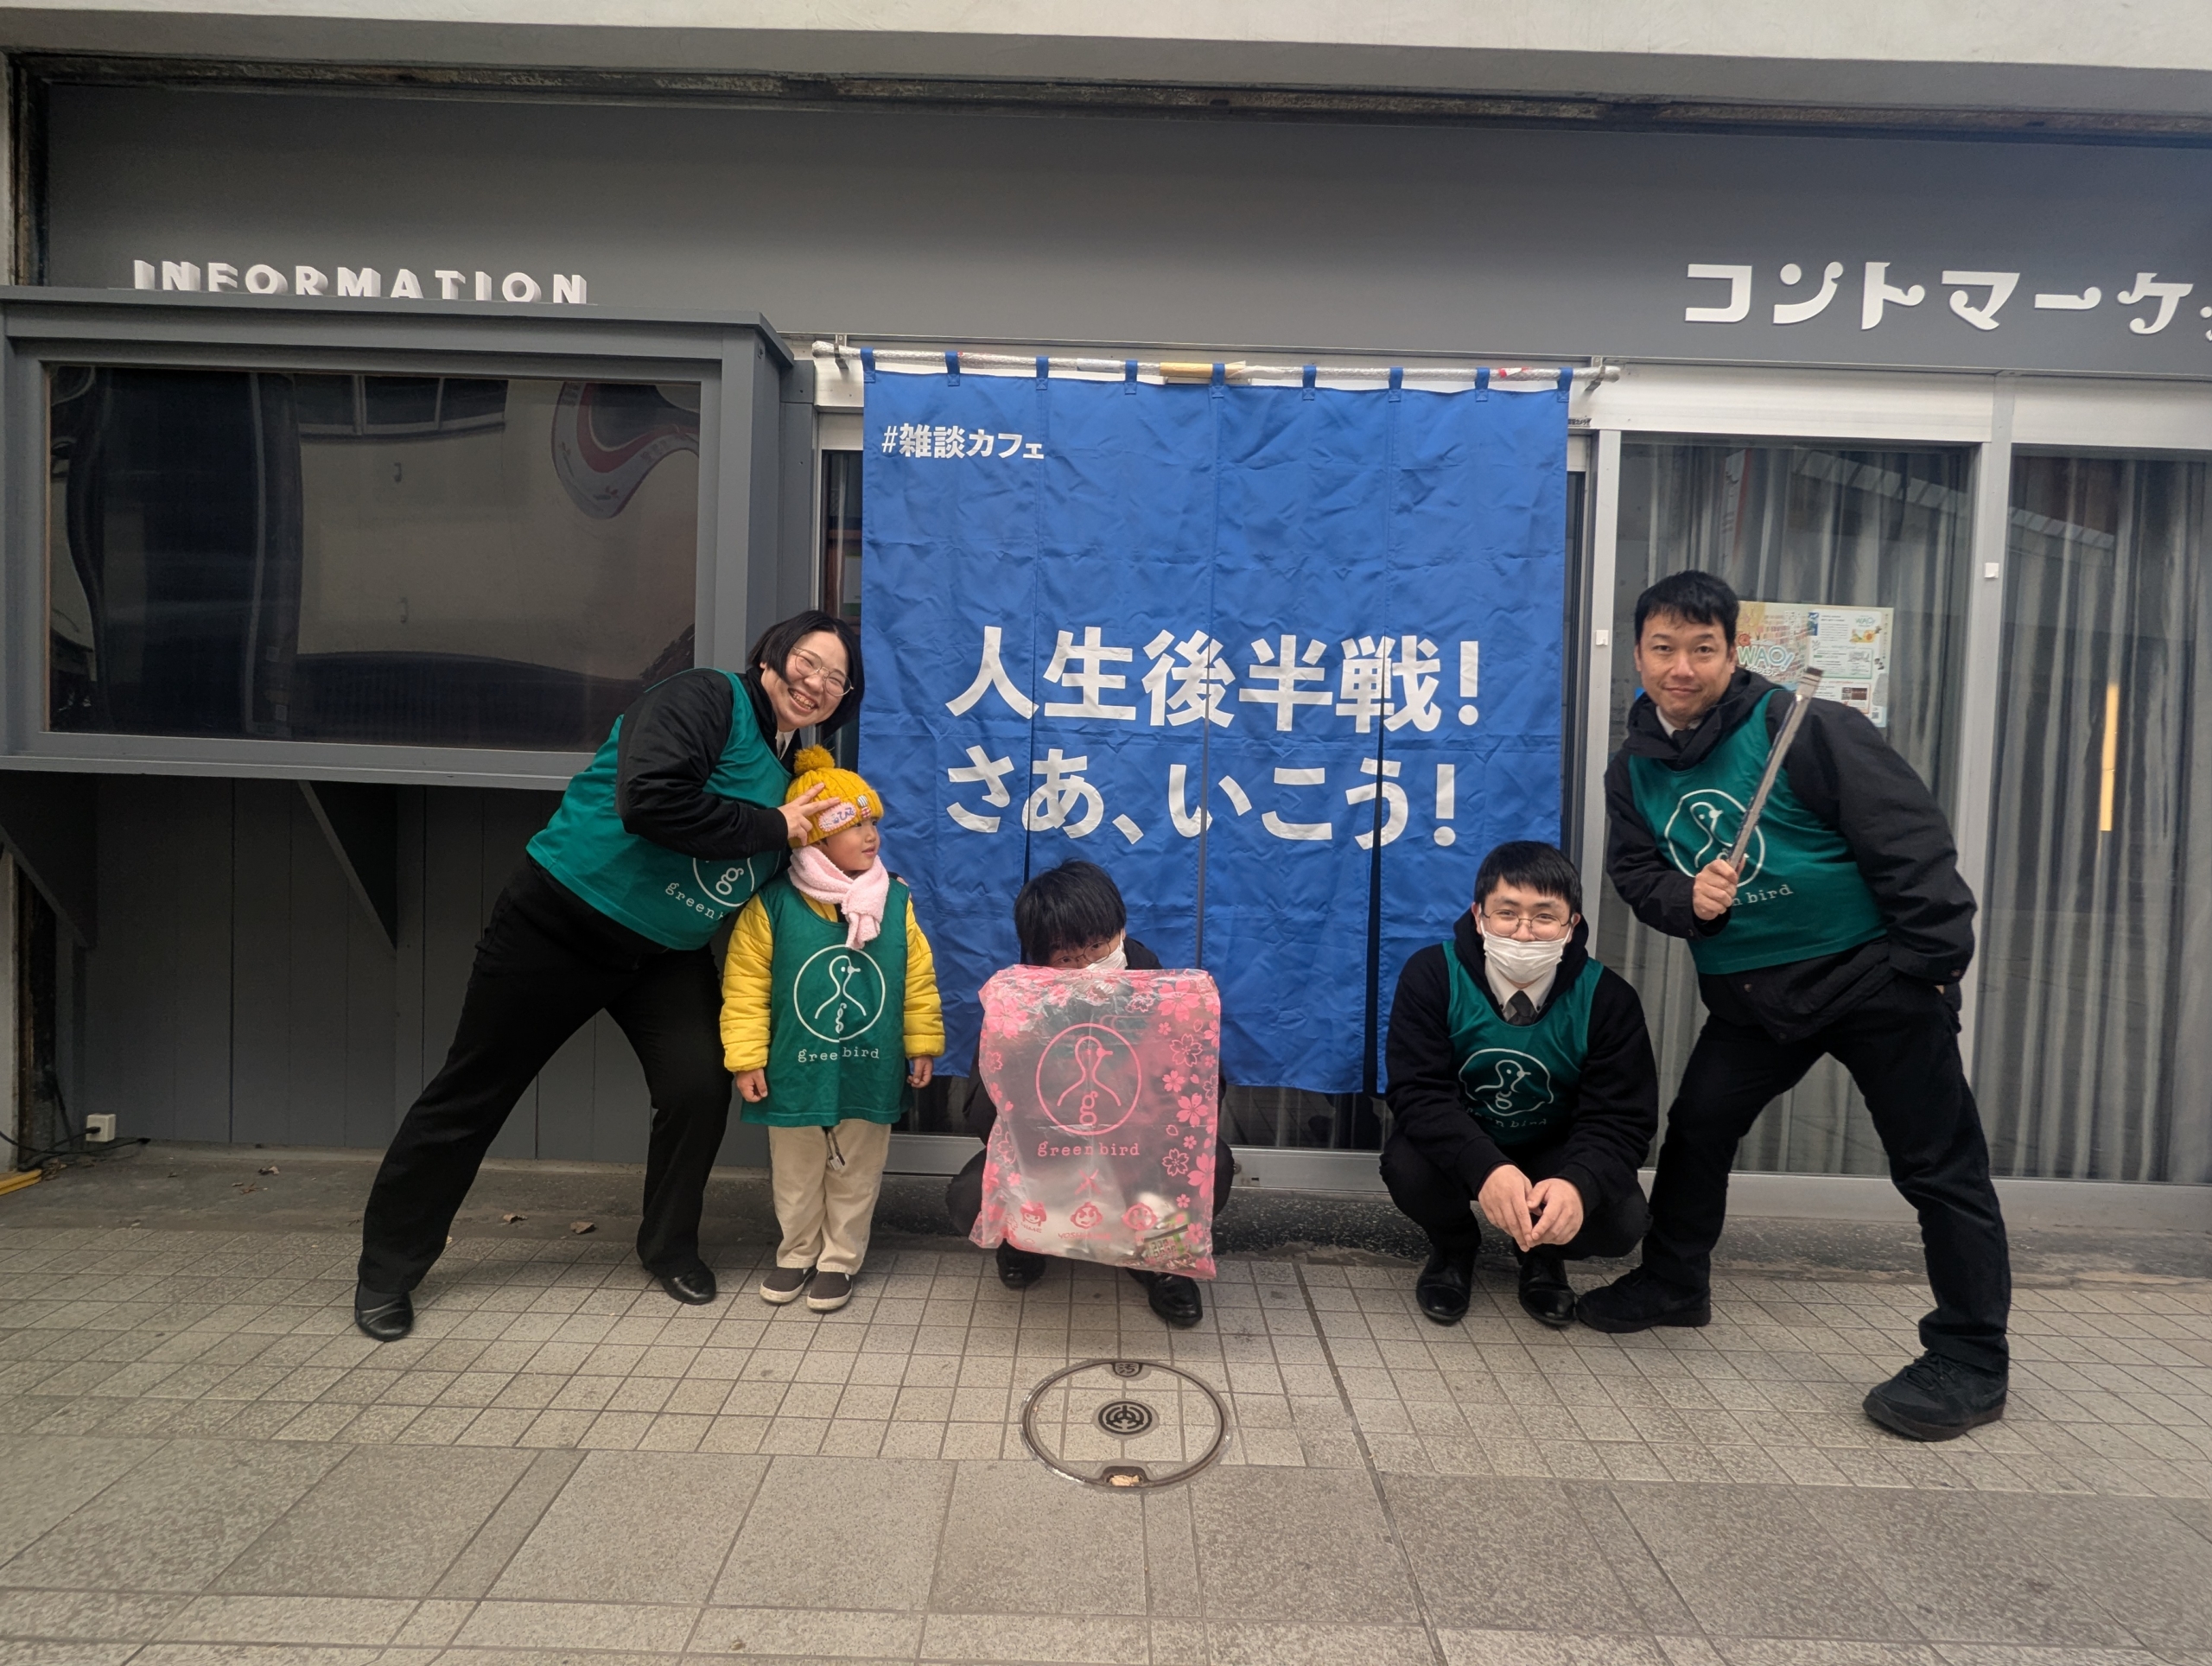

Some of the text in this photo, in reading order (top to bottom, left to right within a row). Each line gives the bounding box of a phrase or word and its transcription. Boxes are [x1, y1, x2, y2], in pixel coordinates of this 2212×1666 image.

[135, 260, 588, 304] INFORMATION
[881, 423, 1045, 459] #雑談カフェ
[945, 626, 1479, 733] 人生後半戦!
[946, 746, 1456, 850] さあ、いこう!
[664, 882, 715, 919] green
[1745, 883, 1795, 904] bird
[842, 1046, 880, 1059] bird
[1037, 1141, 1141, 1157] green bird
